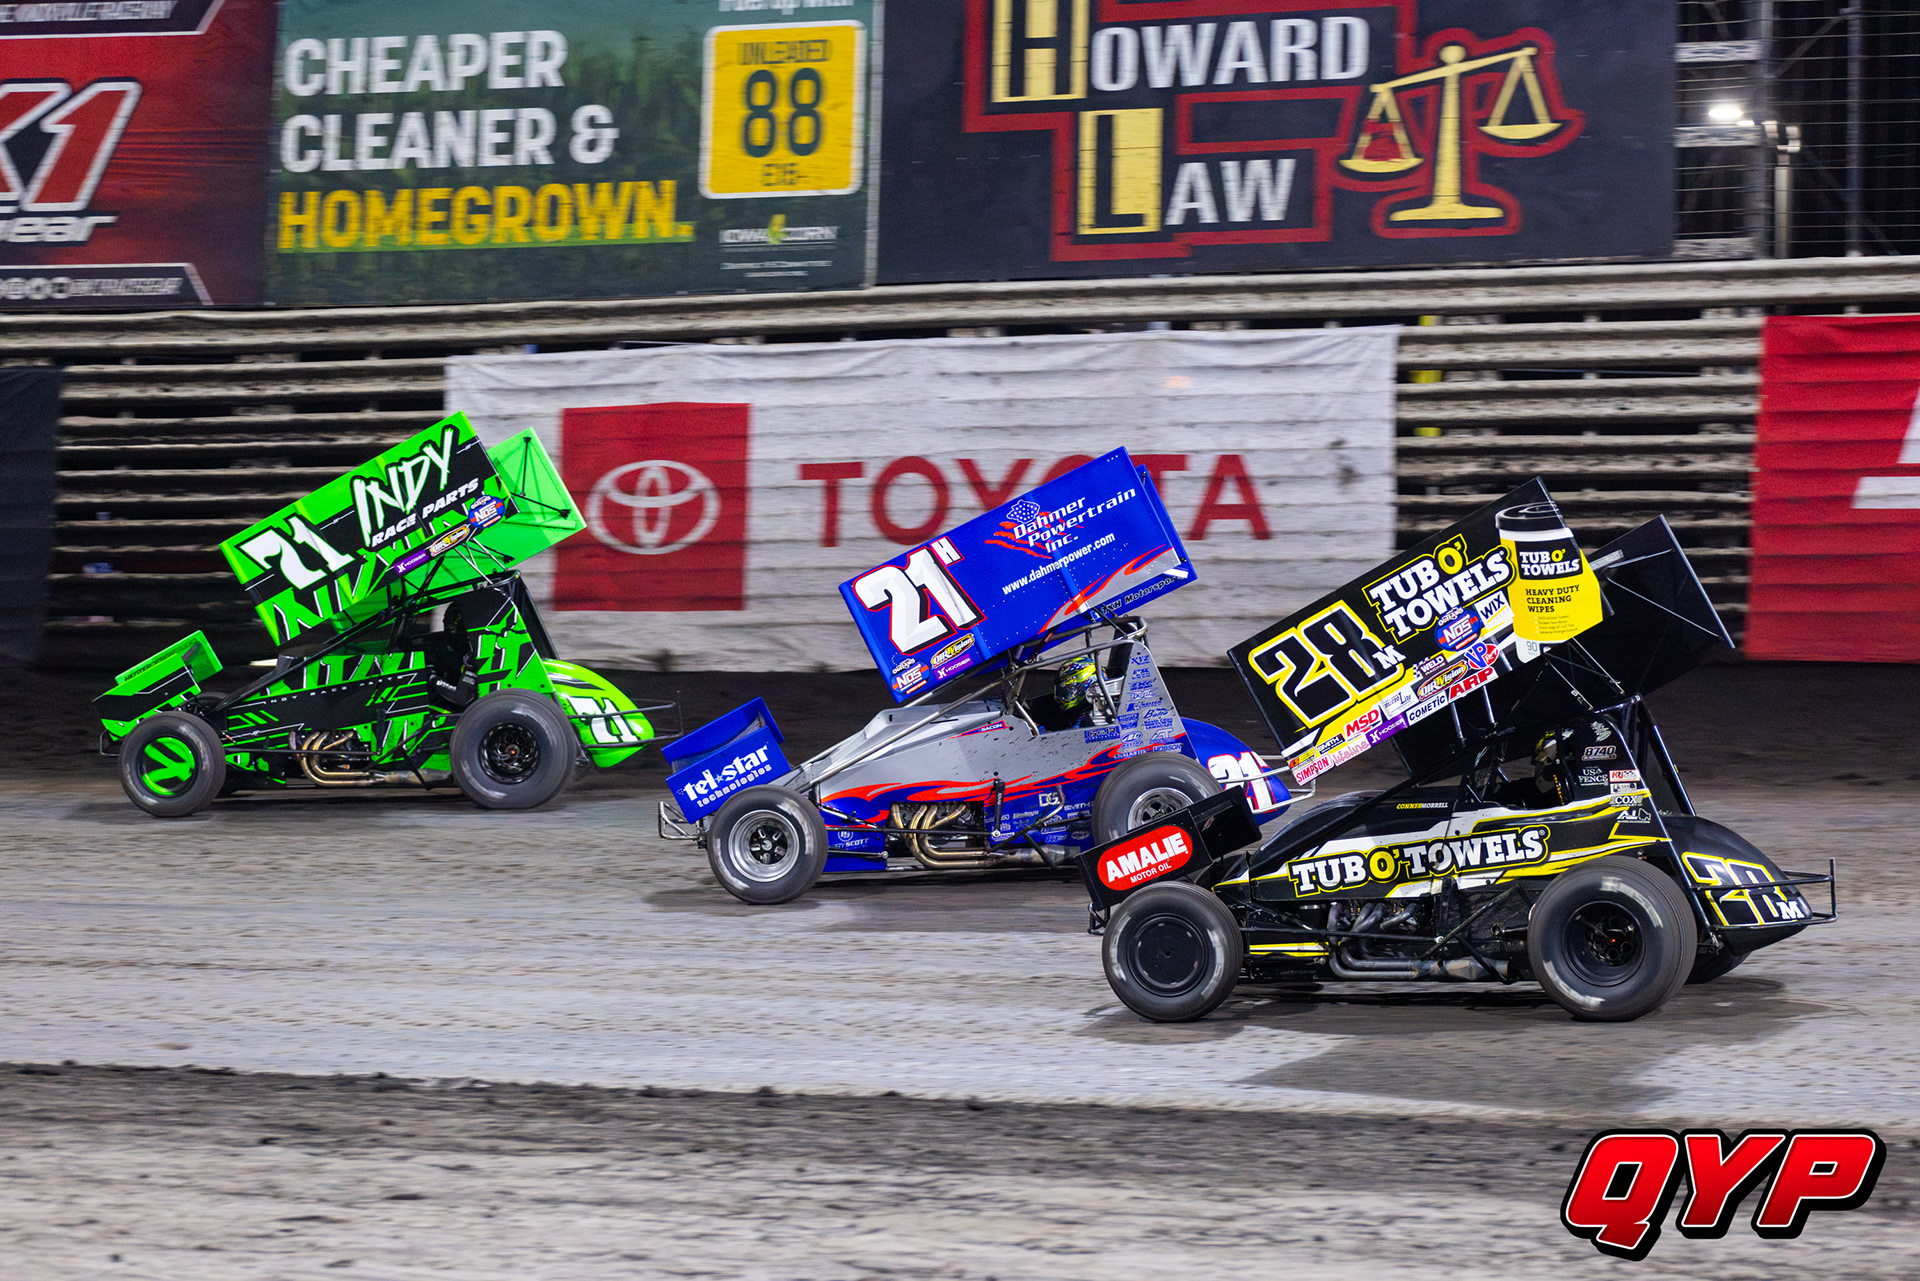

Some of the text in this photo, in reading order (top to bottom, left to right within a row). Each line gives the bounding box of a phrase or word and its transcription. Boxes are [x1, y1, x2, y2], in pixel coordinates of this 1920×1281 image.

[283, 30, 568, 96] CHEAPER
[993, 0, 1369, 103] HOWARD
[741, 68, 824, 157] 88
[280, 105, 619, 172] CLEANER &
[1078, 107, 1296, 235] LAW
[277, 180, 693, 249] HOMEGROWN.
[0, 216, 119, 243] ear
[352, 428, 455, 548] INDY
[799, 455, 1271, 547] TOYTA
[371, 512, 417, 548] RACE
[422, 477, 480, 519] PARTS
[474, 500, 498, 523] NOS
[1013, 497, 1086, 540] Dahmer
[1028, 488, 1137, 546] Powertrain
[240, 515, 355, 590] 71
[1046, 532, 1079, 553] Inc.
[1002, 532, 1116, 595] www.dahmerpower.com
[1519, 551, 1551, 565] TUB
[1521, 559, 1580, 576] TOWELS
[1369, 559, 1440, 612] TUB
[1384, 553, 1511, 638] TOWELS
[1525, 585, 1580, 596] HEAVY DUTY
[1480, 593, 1506, 620] WIX
[1526, 595, 1572, 605] CLEANING
[1527, 605, 1555, 613] WIPES
[1443, 613, 1472, 644] NOS
[1465, 642, 1488, 669] VP
[1526, 641, 1538, 652] 90
[895, 663, 922, 689] NOS
[945, 657, 971, 673] HOOSIER
[1420, 655, 1445, 673] WELD
[1450, 667, 1494, 699] ARP
[981, 723, 1003, 732] BACON
[1346, 708, 1380, 737] MSD
[1585, 746, 1615, 756] 8740
[1295, 756, 1330, 783] SIMPSON
[1578, 774, 1608, 783] FENCE
[1582, 768, 1603, 776] USA
[696, 764, 773, 808] technologies
[1615, 795, 1638, 804] COX
[1106, 832, 1188, 883] AMALIE
[1292, 856, 1367, 892] TUB
[1403, 830, 1544, 874] TOWELS
[1130, 862, 1172, 883] MOTOR OIL
